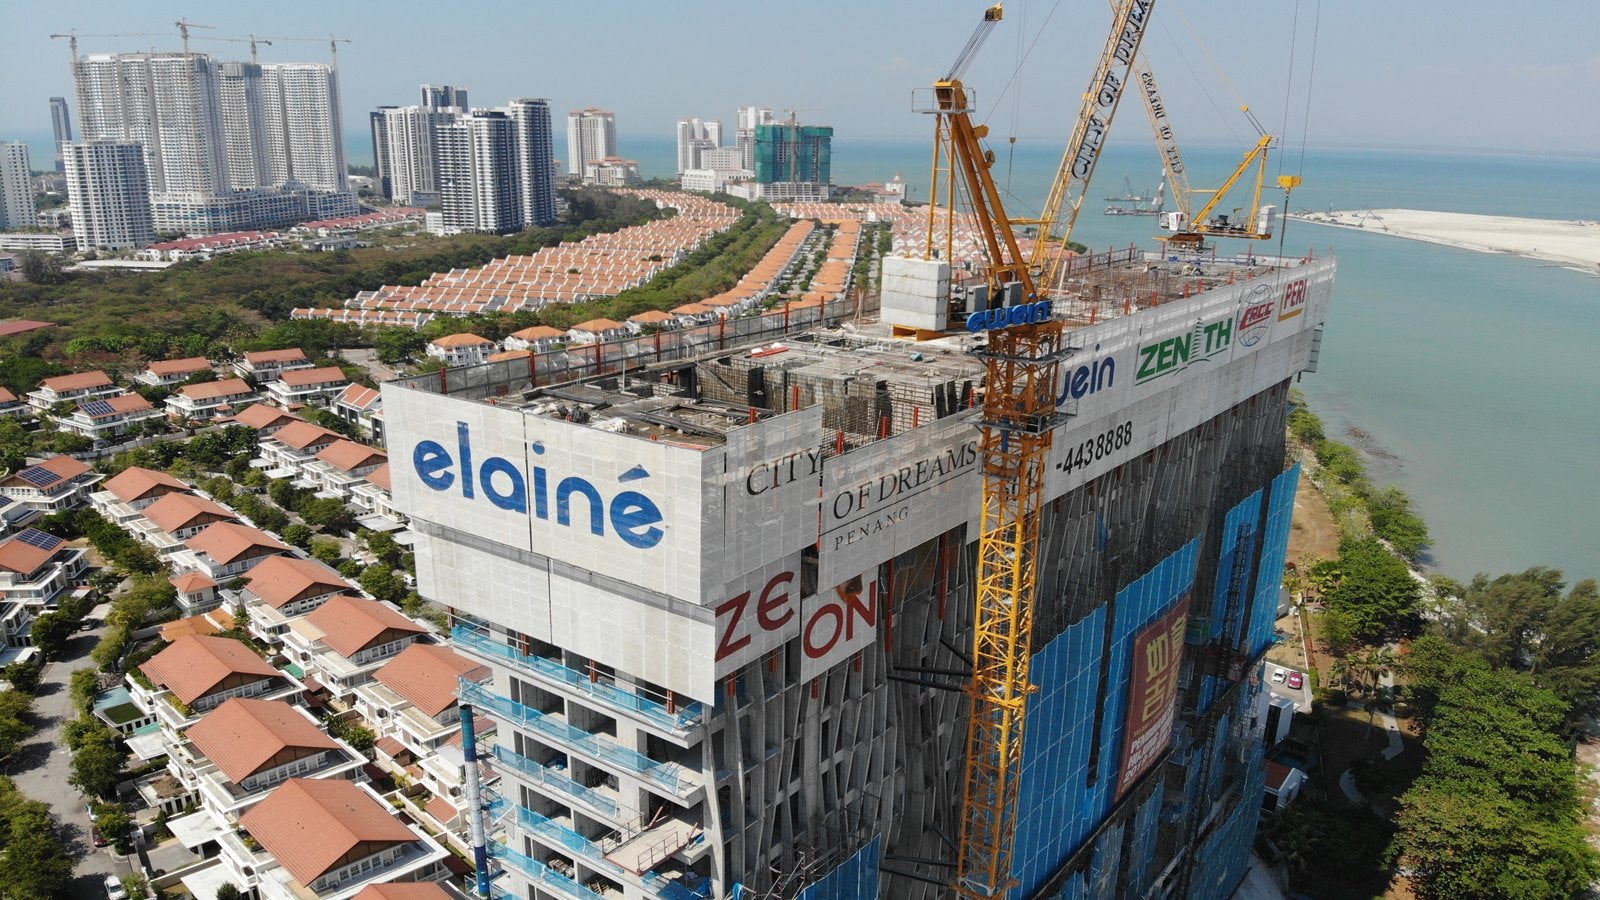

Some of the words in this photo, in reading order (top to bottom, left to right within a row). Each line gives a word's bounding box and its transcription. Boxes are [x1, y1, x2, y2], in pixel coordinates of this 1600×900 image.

[966, 293, 1052, 333] ewein
[1284, 278, 1307, 309] PERI
[1136, 317, 1233, 380] ZENITH
[413, 421, 665, 549] elainé
[746, 446, 823, 496] CITY
[833, 478, 873, 519] OF
[877, 441, 978, 502] DREAMS
[834, 506, 911, 551] PENANG
